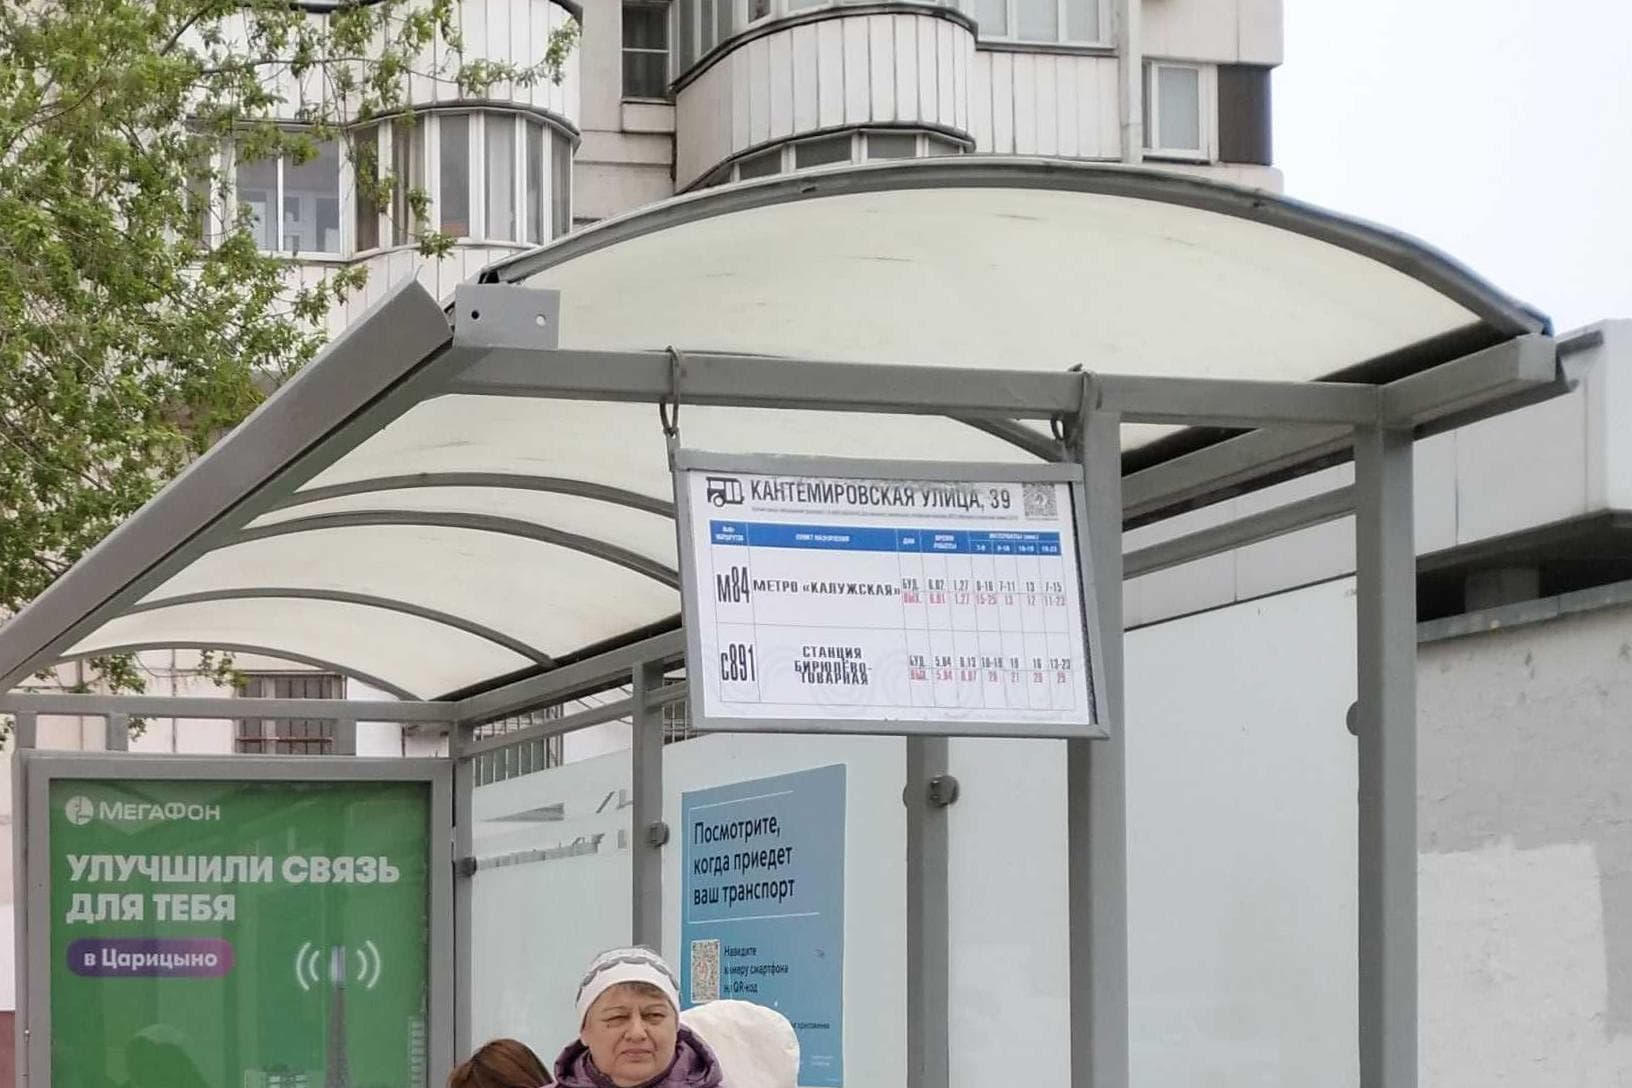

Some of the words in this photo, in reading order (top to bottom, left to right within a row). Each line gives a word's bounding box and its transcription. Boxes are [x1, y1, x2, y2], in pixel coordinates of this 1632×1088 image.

[751, 479, 915, 507] КАНТЕМИРОВСКАЯ
[922, 487, 985, 511] УЛИЦА,
[990, 488, 1011, 509] 39
[753, 579, 798, 593] МЕТРО
[803, 580, 901, 596] «КАЛУЖСКАЯ»
[802, 645, 863, 661] СТАНЦИЯ
[694, 815, 781, 845] Посмотрите,
[66, 853, 274, 883] УЛУЧШИЛИ
[280, 855, 400, 884] СВЯЗЬ
[693, 855, 730, 877] когда
[733, 846, 793, 875] приедет
[66, 892, 144, 924] ДЛЯ
[152, 892, 236, 922] ТЕБЯ
[693, 886, 720, 906] ваш
[722, 878, 796, 908] транспорт
[84, 950, 96, 966] в
[101, 948, 218, 971] Царицыно
